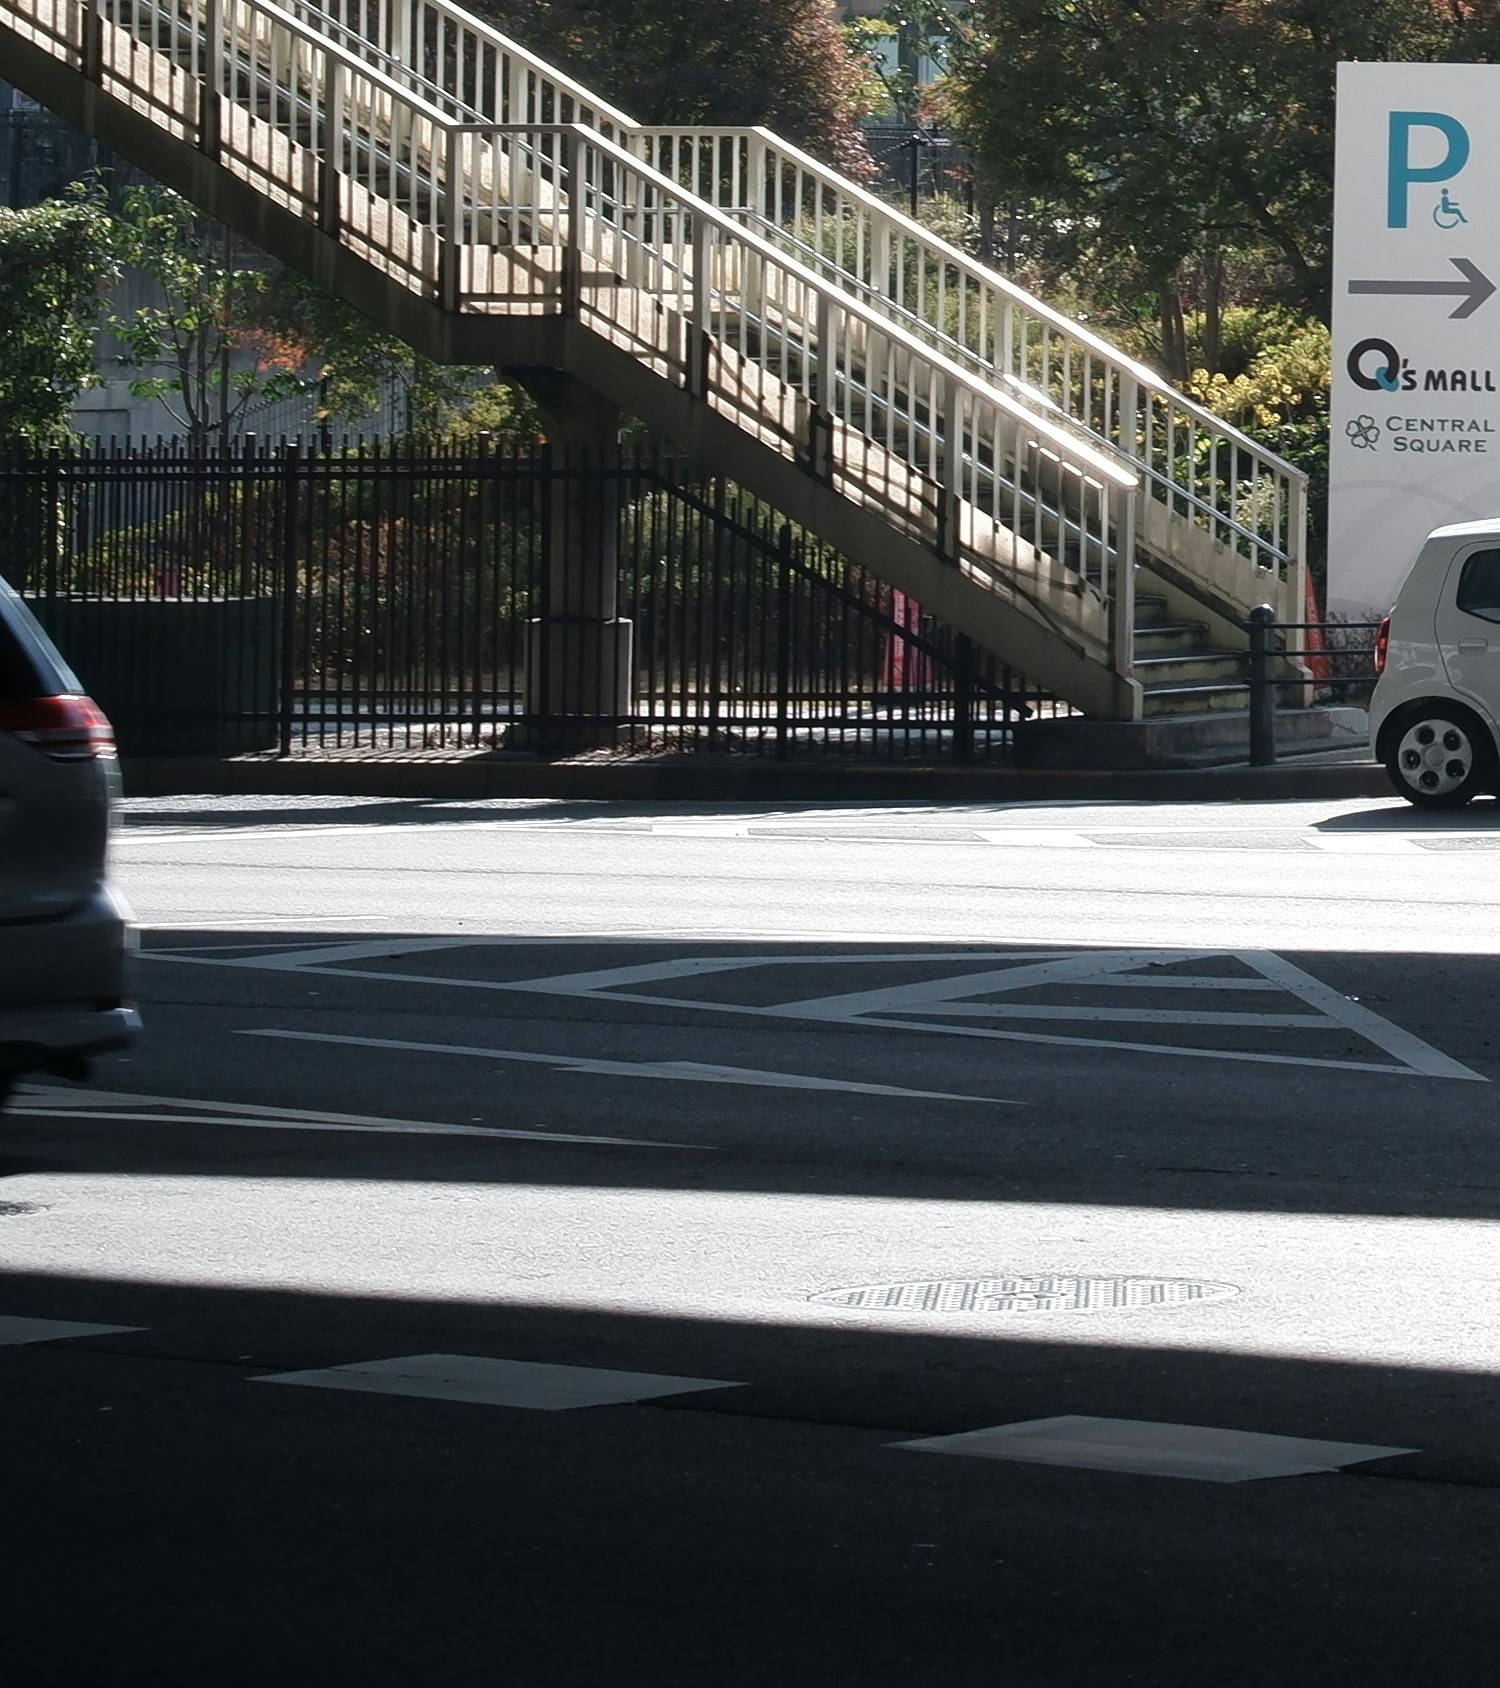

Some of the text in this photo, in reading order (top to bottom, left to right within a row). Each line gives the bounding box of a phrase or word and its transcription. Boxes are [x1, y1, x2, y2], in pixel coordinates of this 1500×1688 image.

[1387, 110, 1471, 230] P
[1424, 368, 1497, 393] MALL
[1385, 415, 1496, 433] CENTRAL
[1392, 436, 1488, 454] SQUARE
